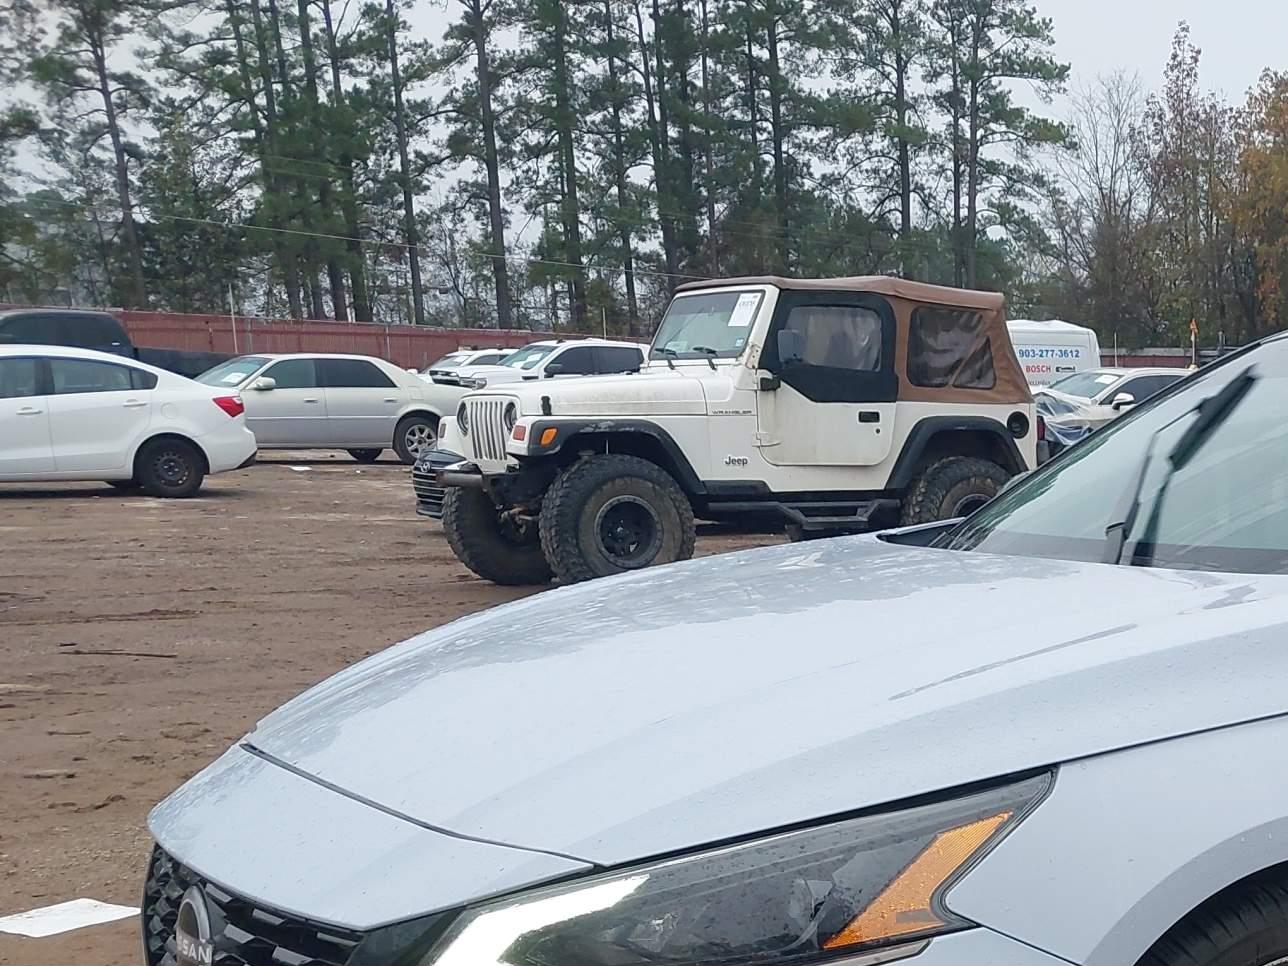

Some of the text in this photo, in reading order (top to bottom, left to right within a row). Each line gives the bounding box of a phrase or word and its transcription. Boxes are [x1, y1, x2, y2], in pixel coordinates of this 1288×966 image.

[1018, 348, 1081, 358] 903-277-3612
[1025, 364, 1052, 373] BOSCH
[724, 455, 748, 467] Jeep
